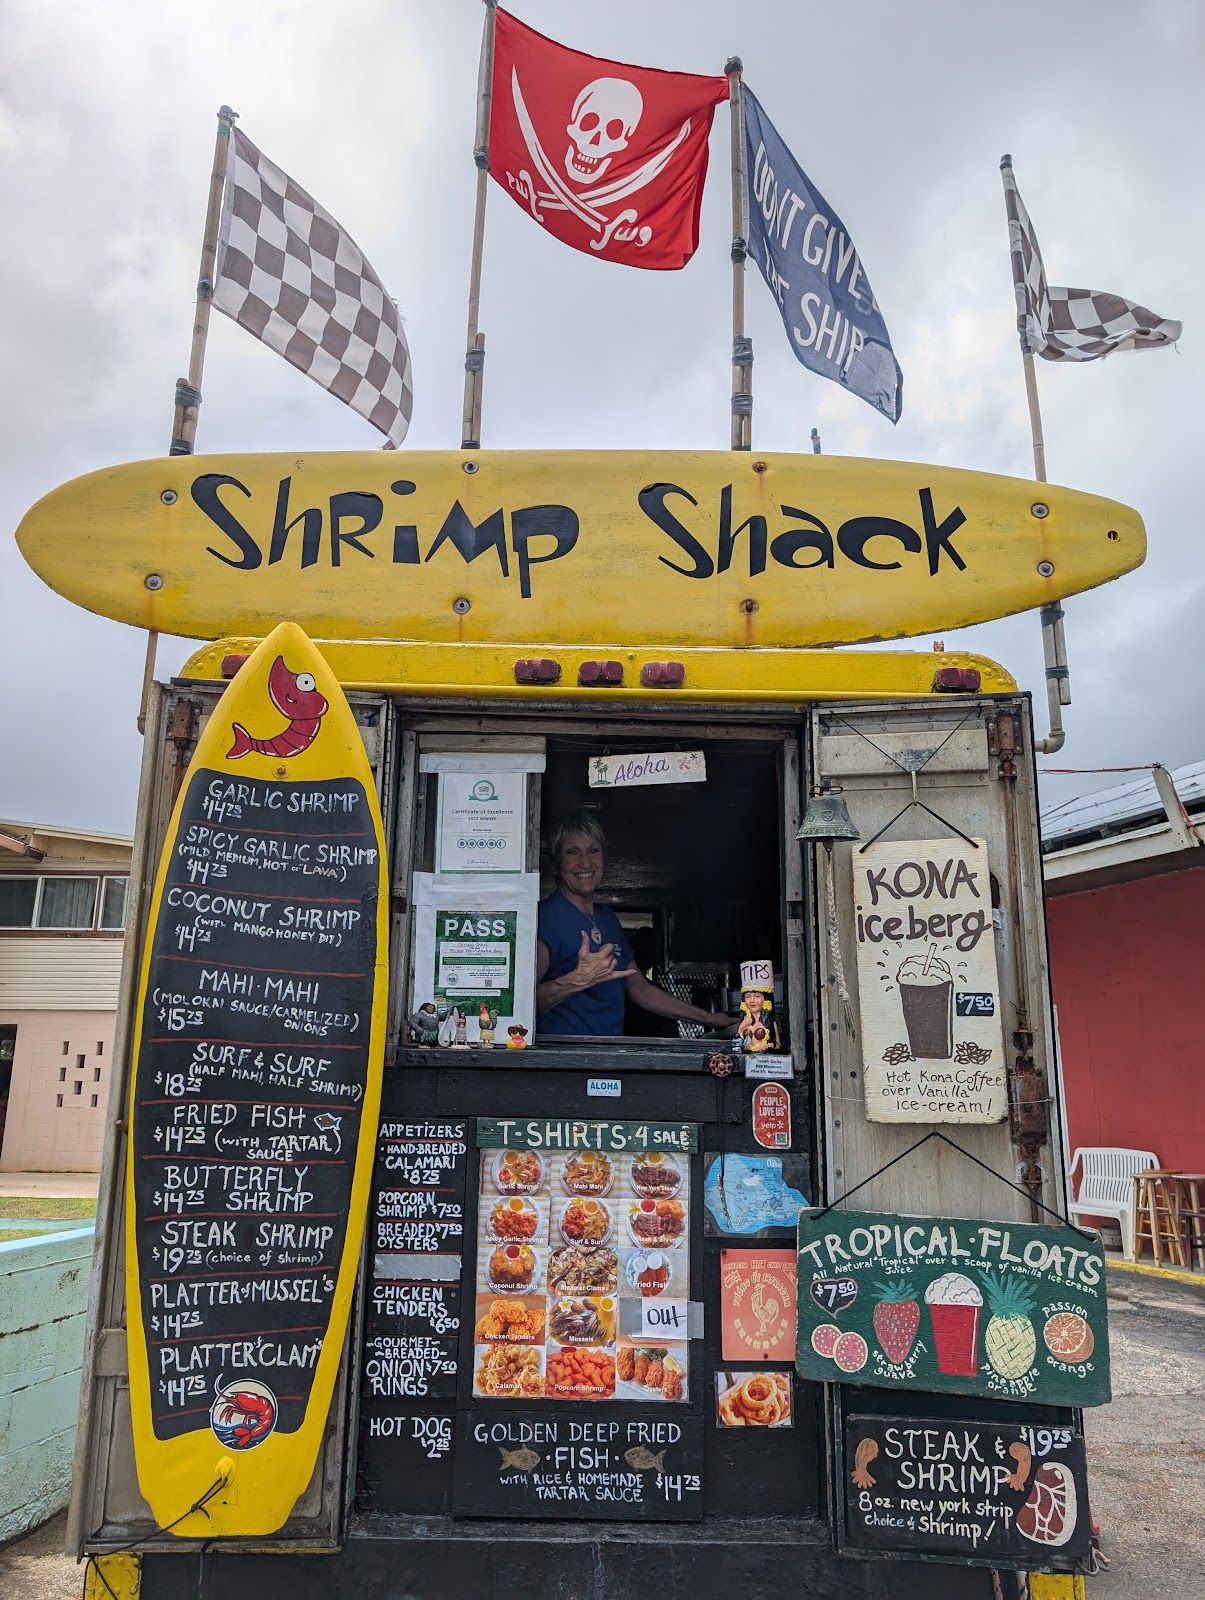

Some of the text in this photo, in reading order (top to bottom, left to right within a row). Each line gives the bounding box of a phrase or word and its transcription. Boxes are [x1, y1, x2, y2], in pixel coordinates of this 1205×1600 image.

[802, 213, 862, 299] GIVE
[794, 293, 864, 373] SHIP
[638, 482, 967, 579] Shack
[615, 755, 669, 784] Aloha
[209, 780, 359, 813] GARLIC SHRIMP
[186, 826, 377, 866] SPICY GARLIC SHRIMP
[263, 859, 289, 871] HOT
[867, 859, 980, 905] KONA
[168, 888, 360, 930] COCONUT SHRIMP
[445, 920, 505, 936] PASS
[857, 905, 992, 952] iceberg
[742, 964, 769, 983] TIPS
[153, 988, 224, 1008] (MOLOKAI
[284, 1019, 328, 1036] ONIONS
[193, 1043, 331, 1078] SURF & SURF
[189, 1062, 226, 1078] (HALF
[269, 1074, 304, 1088] HALF
[309, 1081, 363, 1102] SHRIMP)
[590, 1082, 618, 1090] ALOHA
[882, 1084, 969, 1097] over Vanilla
[886, 1070, 1002, 1091] Hot Kona Coffee
[760, 1097, 783, 1105] PEOPLE
[760, 1107, 784, 1116] LOVE US
[174, 1104, 306, 1128] FRIED FISH
[653, 1126, 690, 1150] SALE
[246, 1149, 293, 1162] SAUCE
[385, 1156, 455, 1169] CALAMARI
[164, 1166, 308, 1192] BUTTERFLY
[226, 1192, 313, 1213] SHRIMP
[378, 1191, 435, 1206] POPCORN
[376, 1204, 427, 1218] SHRIMP
[161, 1221, 334, 1248] STEAK SHRIMP
[378, 1223, 435, 1238] BREADED
[377, 1237, 438, 1251] OYSTERS
[206, 1251, 251, 1269] (choice
[259, 1251, 272, 1266] of
[278, 1251, 323, 1266] shrimp)
[800, 1225, 1102, 1285] TROPICAL FLOATS
[813, 1270, 827, 1280] All
[835, 1258, 873, 1274] Natural
[964, 1258, 992, 1273] scoop
[998, 1262, 1009, 1273] of
[1012, 1265, 1041, 1278] vanilla
[885, 1266, 913, 1274] Juice
[151, 1281, 241, 1308] PLATTER
[374, 1286, 442, 1301] CHICKEN
[373, 1300, 448, 1318] TENDERS
[160, 1342, 257, 1375] PLATTER
[872, 1340, 928, 1371] strawberry
[366, 1359, 424, 1377] ONION
[873, 1367, 916, 1379] guava
[1047, 1355, 1094, 1378] orange
[370, 1377, 428, 1396] RINGS
[988, 1380, 1037, 1397] orange
[370, 1417, 451, 1440] HOT DOG
[474, 1422, 681, 1444] GOLDEN DEEP FRIED
[885, 1428, 984, 1462] STEAK
[995, 1437, 1006, 1459] &
[555, 1447, 609, 1469] FISH
[533, 1474, 562, 1484] RICE
[566, 1471, 572, 1485] &
[578, 1473, 644, 1488] HOMEMADE
[898, 1462, 1011, 1495] SHRIMP
[536, 1486, 643, 1502] TARTAR SAUCE
[859, 1491, 872, 1511] 8
[901, 1499, 934, 1512] new
[936, 1498, 970, 1521] york
[976, 1499, 1013, 1529] strip
[864, 1512, 904, 1527] choice
[907, 1516, 915, 1530] of
